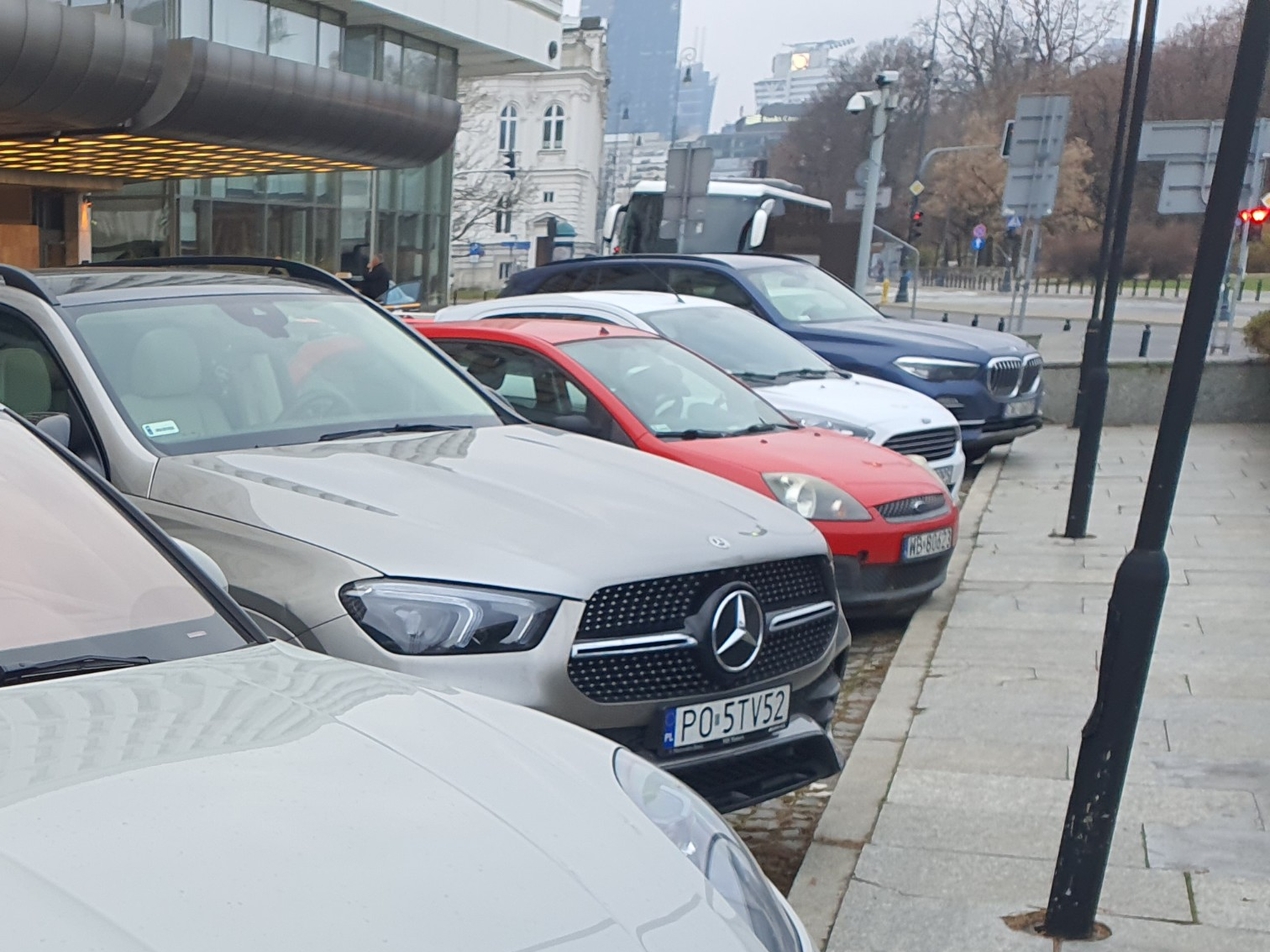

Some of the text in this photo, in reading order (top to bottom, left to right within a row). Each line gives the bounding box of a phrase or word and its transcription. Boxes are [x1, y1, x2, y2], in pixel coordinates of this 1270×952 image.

[681, 690, 786, 742] PO 5TV52
[663, 732, 674, 743] PL
